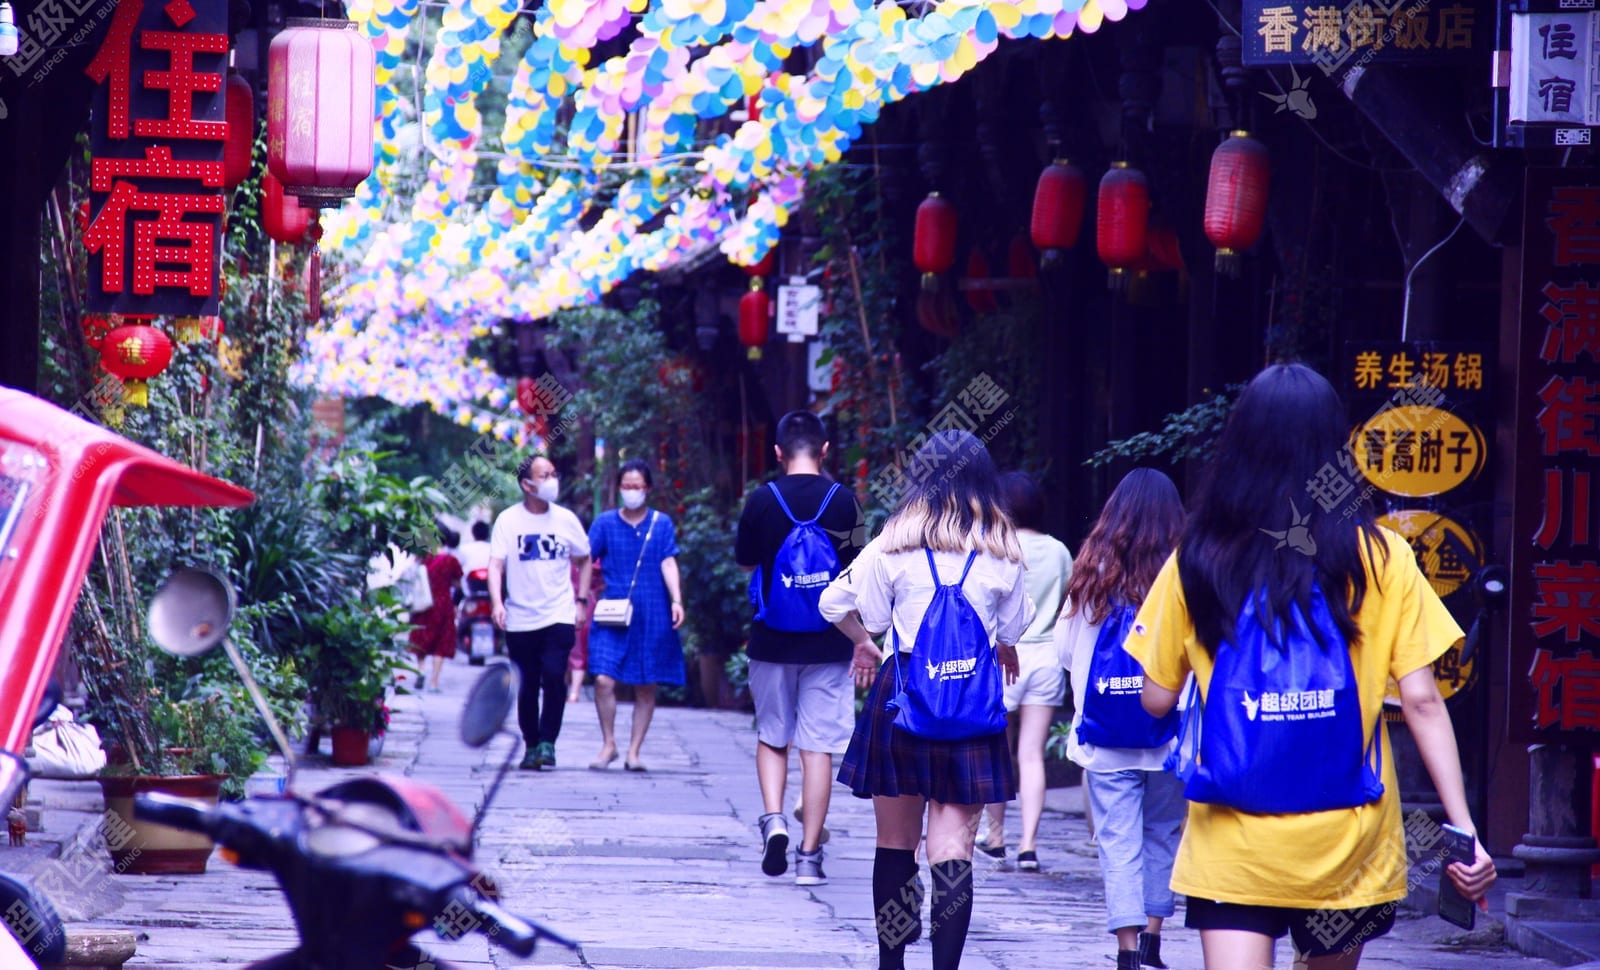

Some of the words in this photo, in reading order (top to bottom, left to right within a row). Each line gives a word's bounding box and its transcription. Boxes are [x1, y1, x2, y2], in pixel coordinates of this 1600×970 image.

[1257, 6, 1476, 53] 香满街饭店
[1538, 23, 1577, 113] 住宿
[82, 0, 231, 296] 住宿
[1354, 351, 1483, 390] 养生汤锅
[1530, 186, 1600, 732] 香满街川菜馆
[1109, 676, 1144, 689] 超级团
[1261, 689, 1335, 713] 超级团建
